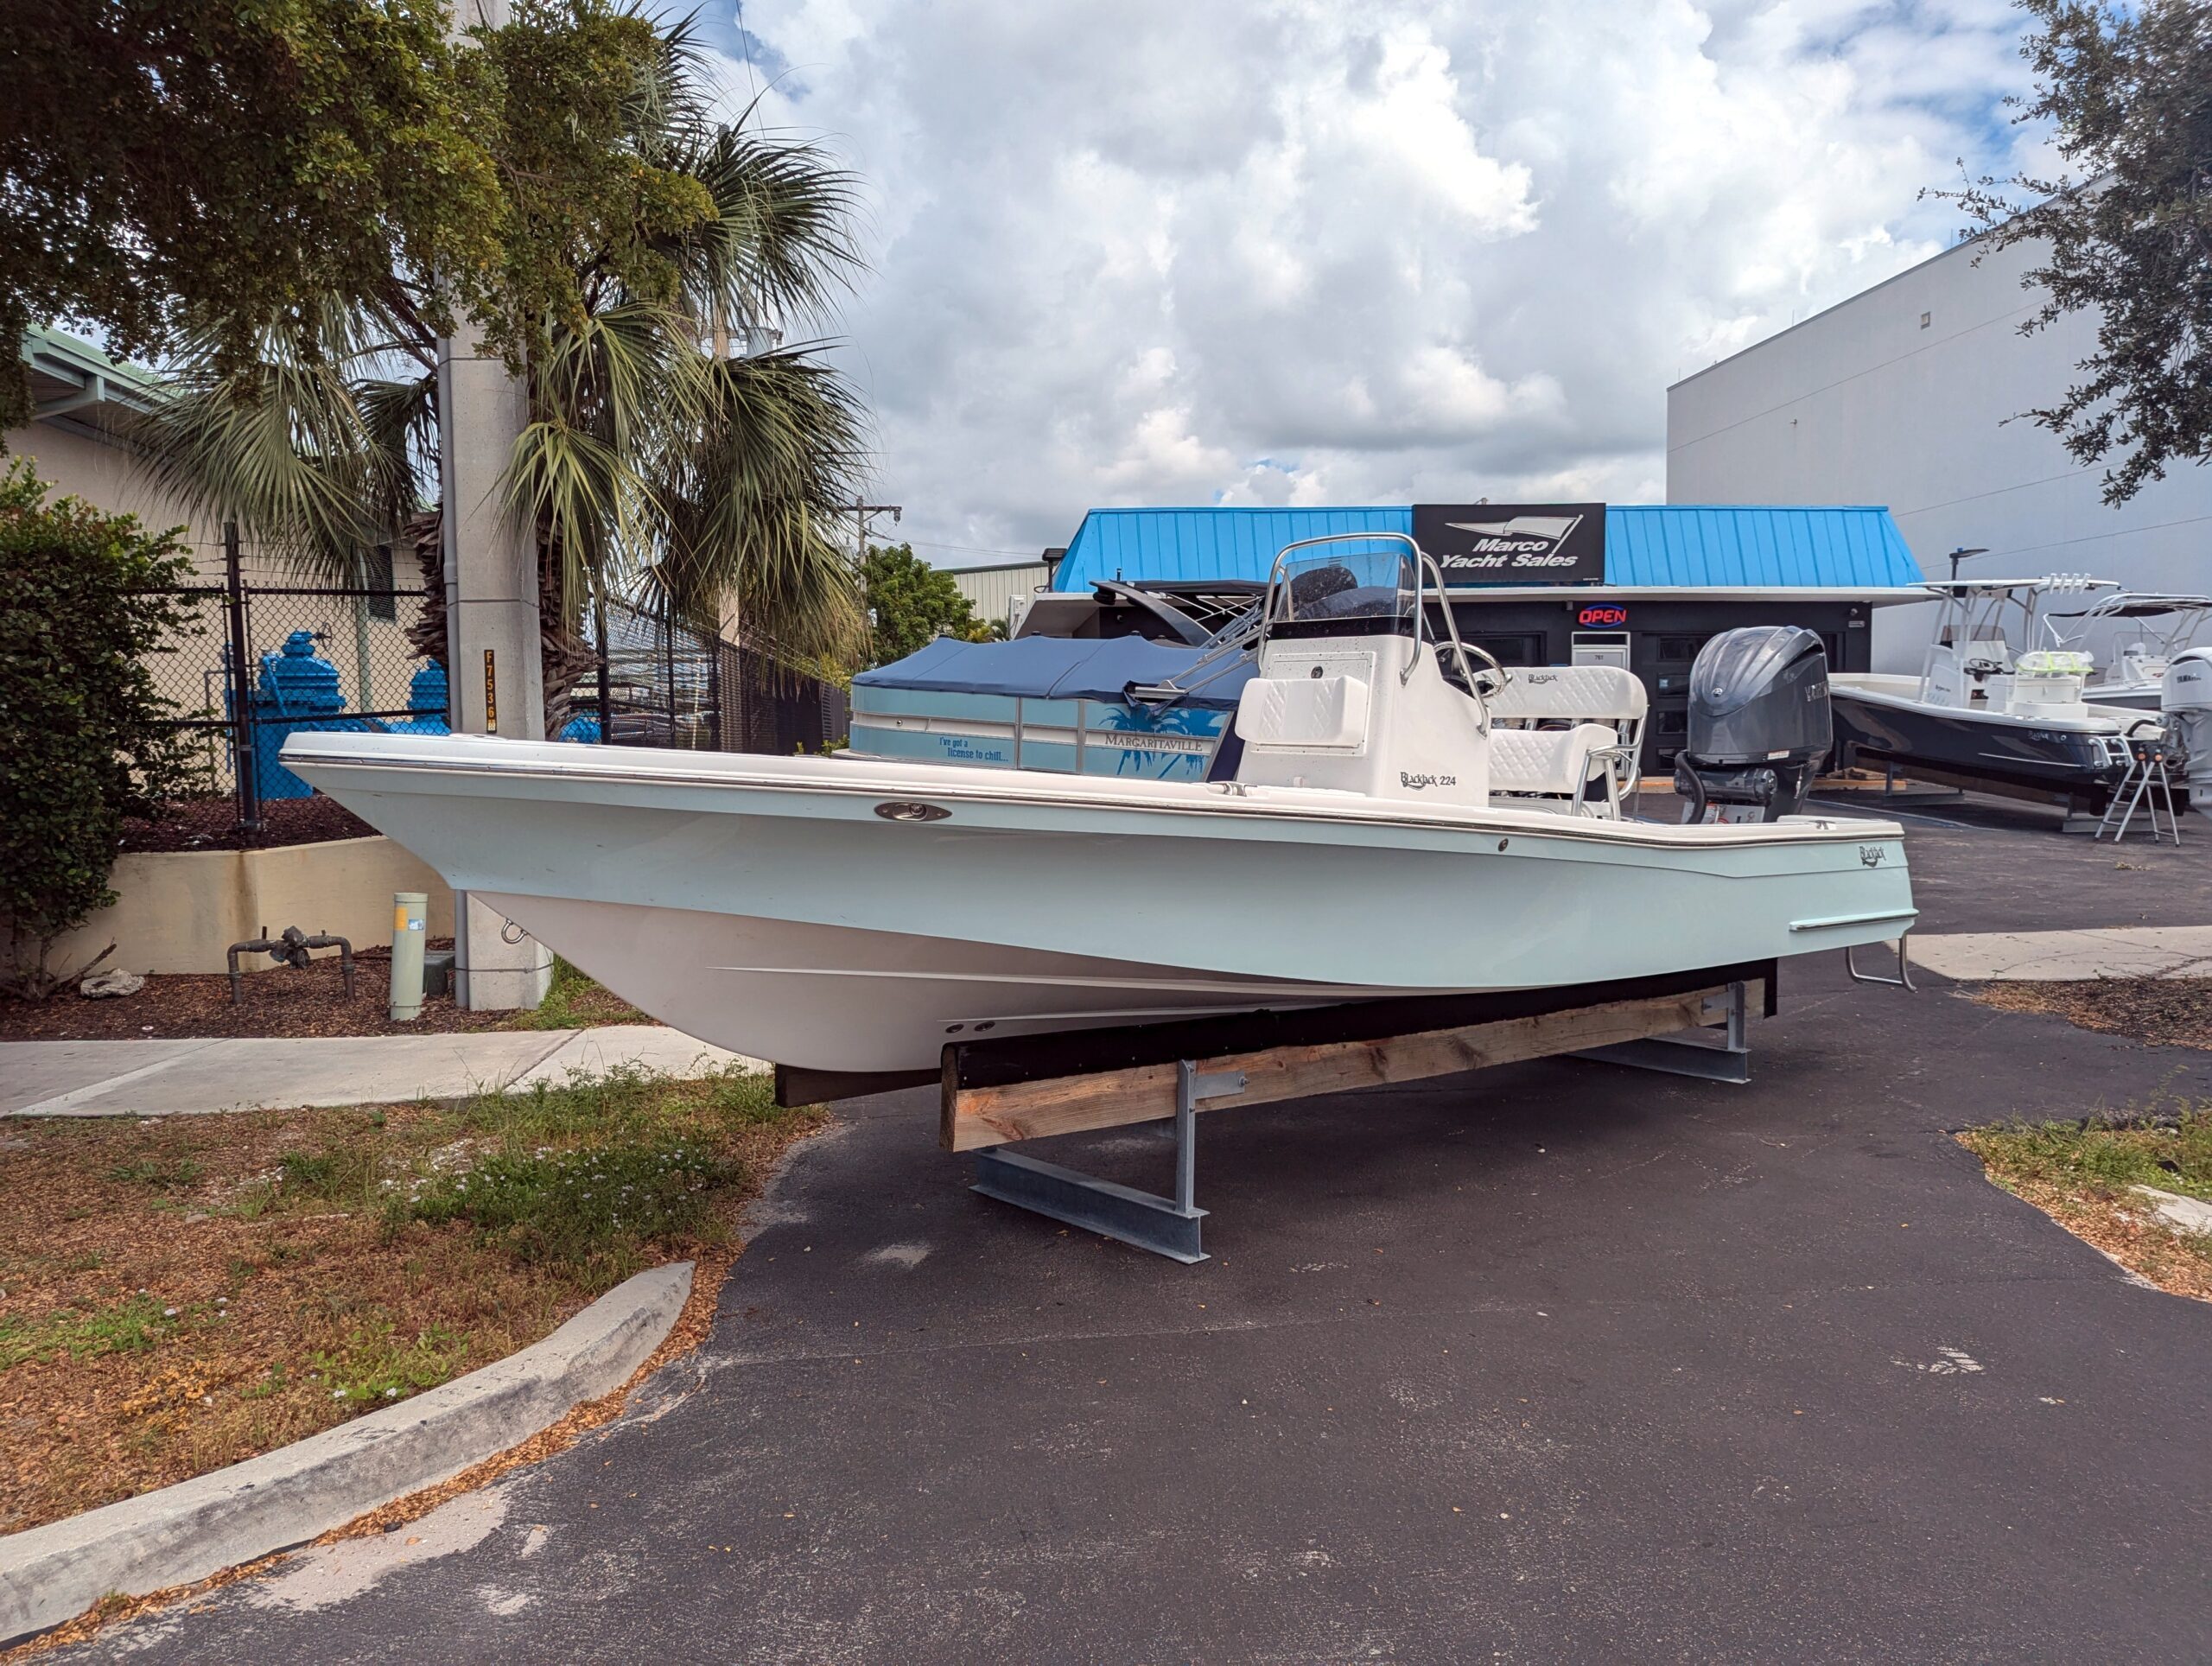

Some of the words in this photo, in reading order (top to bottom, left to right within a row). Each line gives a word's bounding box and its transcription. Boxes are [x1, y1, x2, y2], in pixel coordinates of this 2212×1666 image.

[1472, 538, 1548, 552] Marco
[1440, 554, 1509, 568] Yacht
[1511, 553, 1579, 567] Sales
[1579, 609, 1627, 623] OPEN
[486, 652, 495, 718] F7536
[939, 736, 951, 746] I've
[952, 739, 963, 748] got
[1105, 733, 1203, 752] MARGARITAVILLE
[947, 747, 974, 759] license
[976, 749, 982, 760] to
[1440, 776, 1456, 785] 224
